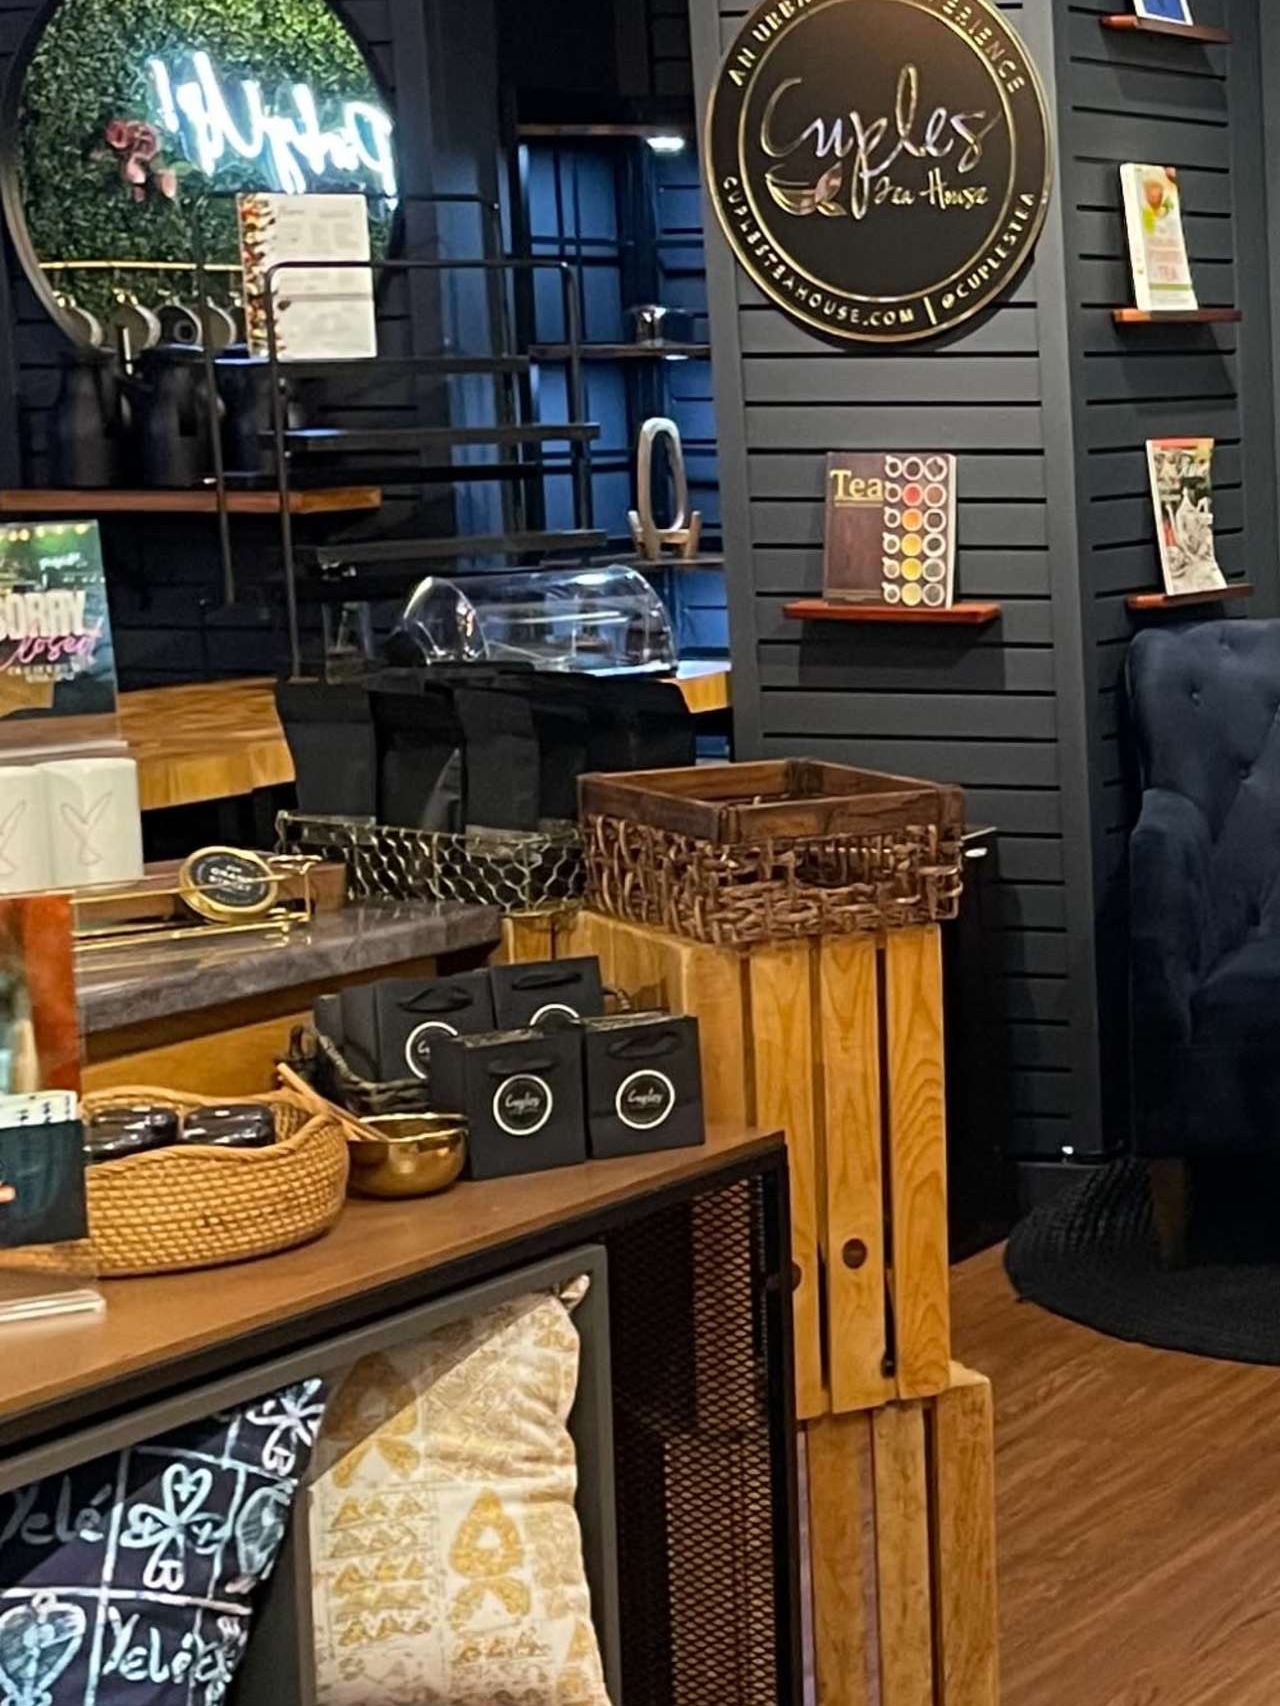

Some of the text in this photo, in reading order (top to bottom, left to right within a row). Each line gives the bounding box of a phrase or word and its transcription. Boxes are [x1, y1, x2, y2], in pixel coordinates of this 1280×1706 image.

[728, 47, 756, 86] AN
[760, 63, 1000, 221] Cuples
[873, 167, 990, 211] Tea House
[829, 469, 884, 501] Tea
[102, 1605, 195, 1684] Yelé
